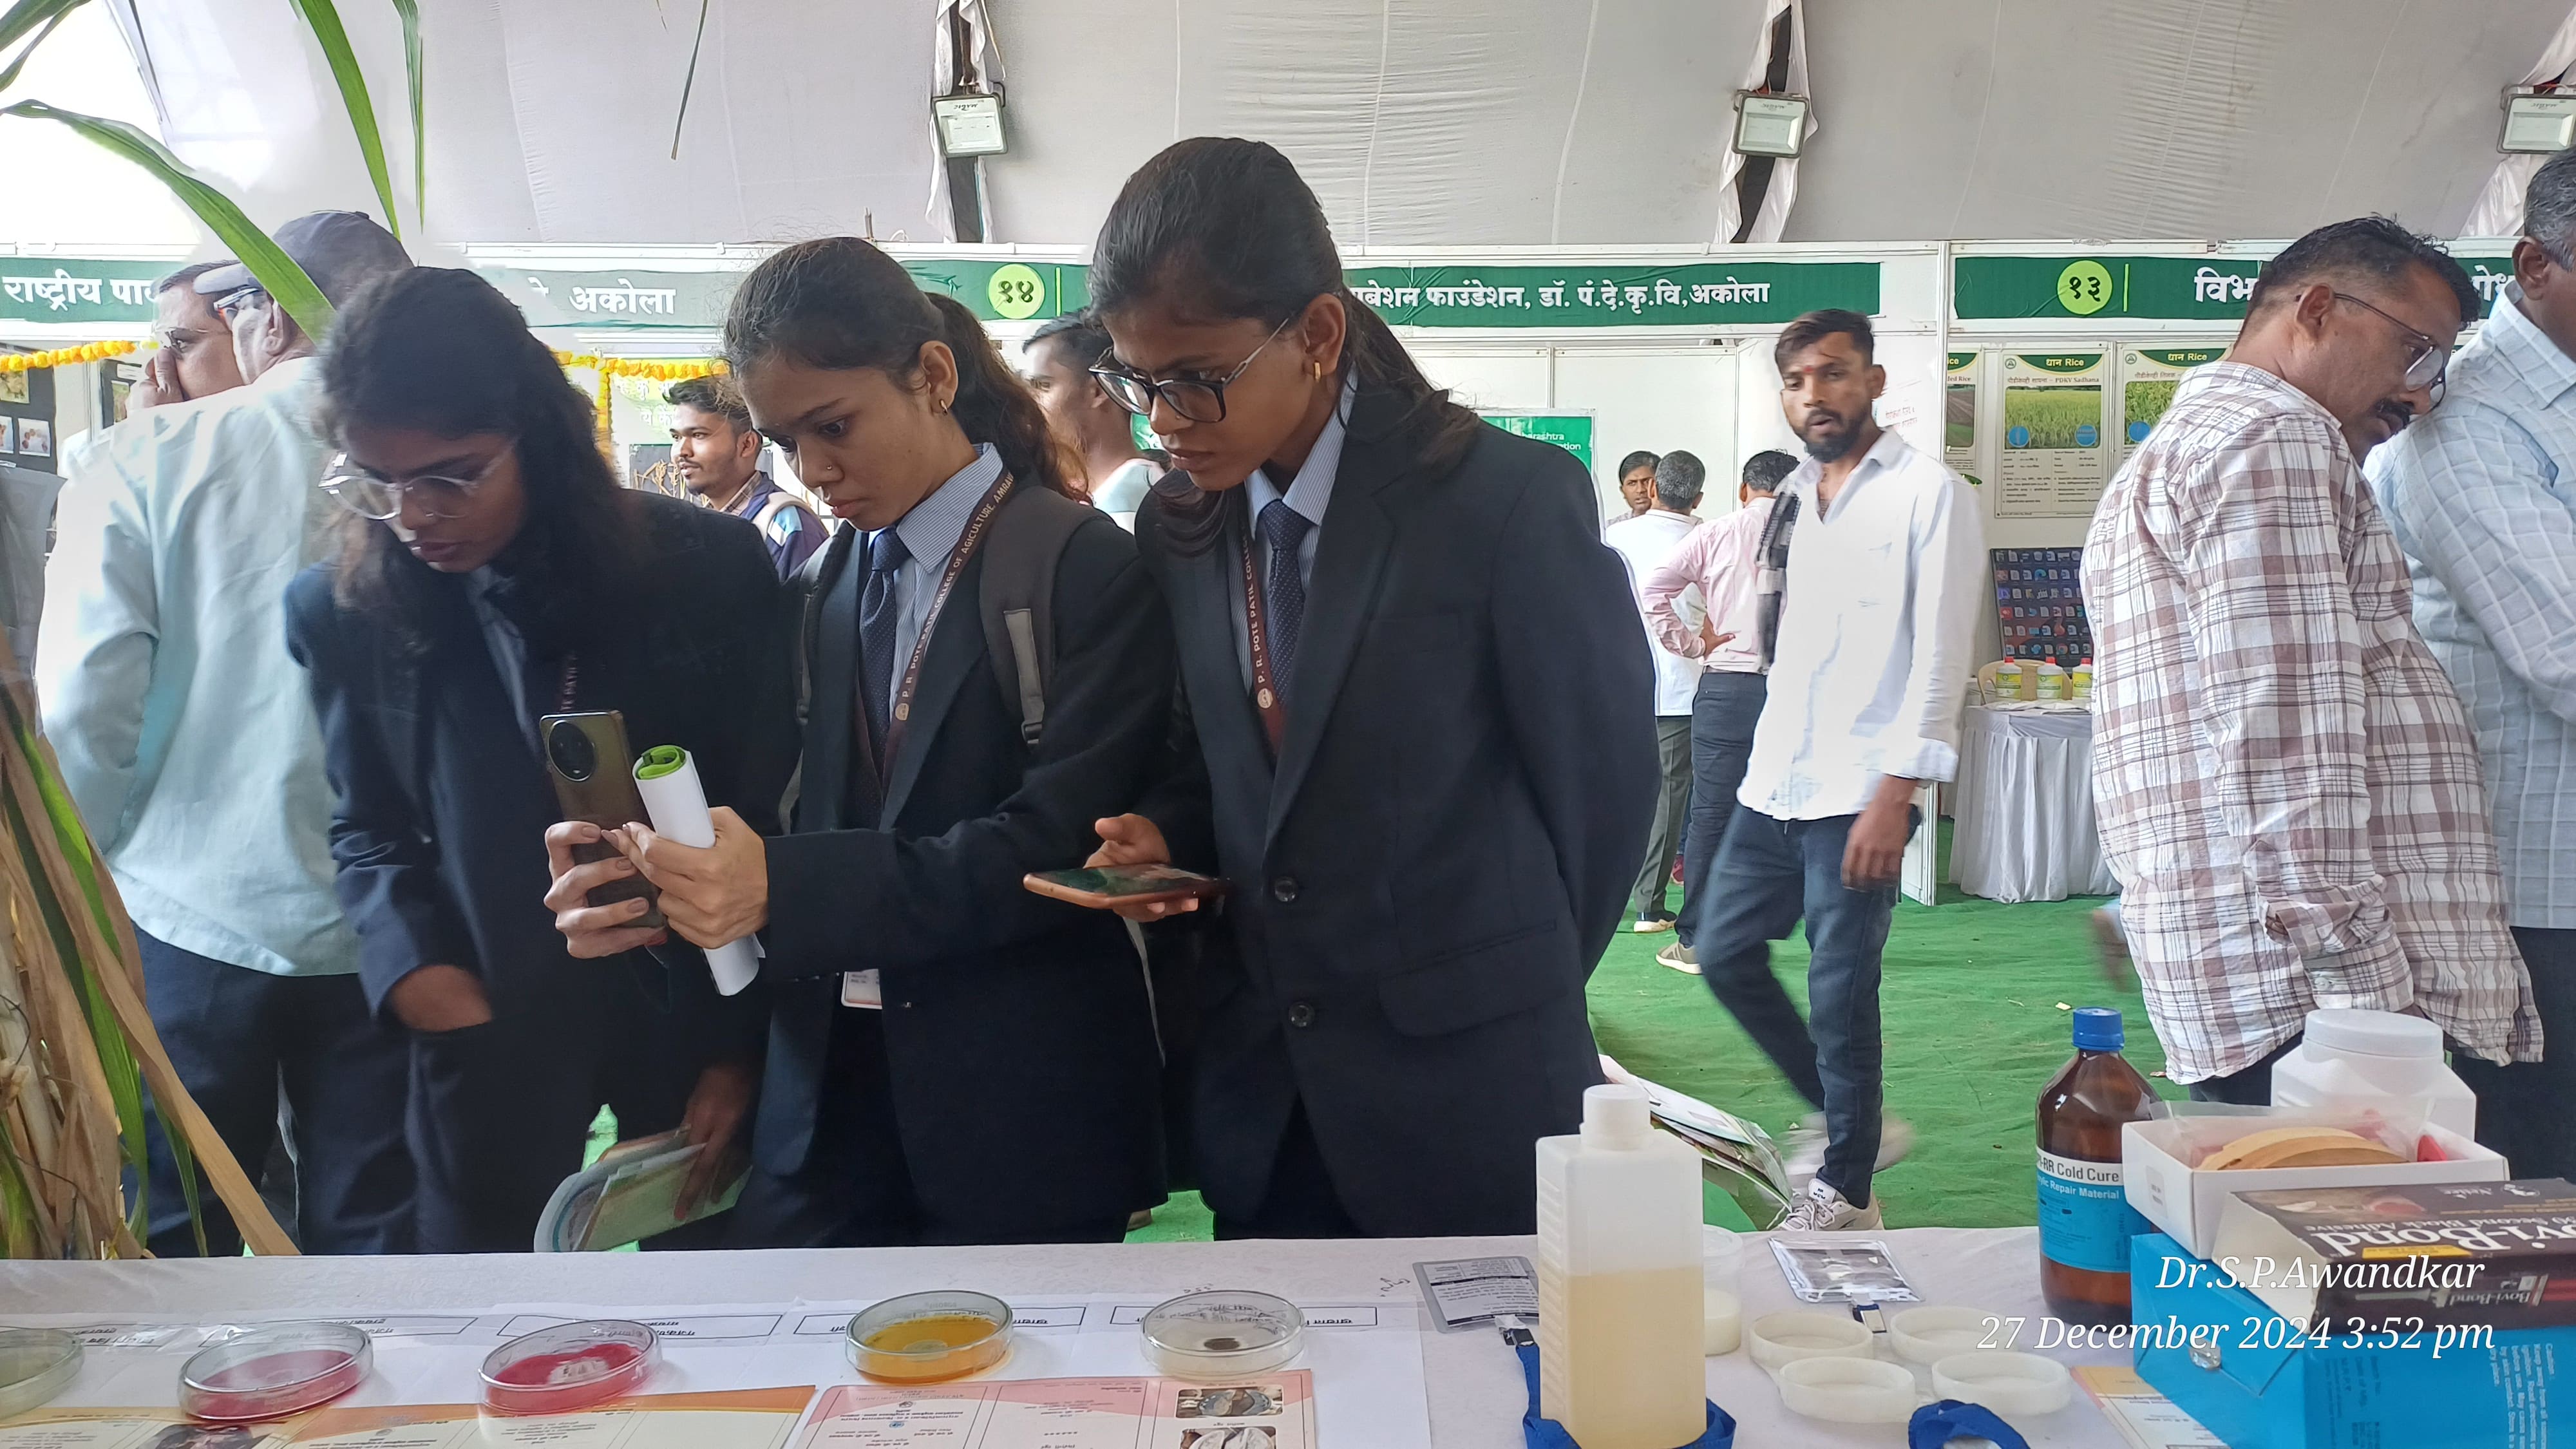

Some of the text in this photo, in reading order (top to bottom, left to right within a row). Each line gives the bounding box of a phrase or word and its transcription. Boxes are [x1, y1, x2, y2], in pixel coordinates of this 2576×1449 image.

[3, 269, 102, 312] राष्ट्रीय
[998, 281, 1034, 303] १४
[1425, 279, 1531, 310] फाउंडेशन,
[1538, 279, 1570, 307] डॉ.
[2069, 276, 2101, 302] १३
[2194, 267, 2259, 303] विभ
[569, 278, 676, 315] अकोला
[2046, 358, 2085, 366] धान Rice
[2168, 353, 2208, 361] धान Rice
[1247, 585, 1256, 618] PATIL
[910, 647, 922, 670] POTE
[934, 571, 956, 608] COLLEGE
[953, 556, 963, 568] OF
[1251, 622, 1261, 652] POTE
[2057, 1163, 2083, 1180] Cold
[2087, 1168, 2119, 1182] Cure
[2050, 1180, 2076, 1195] Repair
[2079, 1188, 2119, 1200] Material
[2304, 1221, 2396, 1233] Adhesive
[2402, 1220, 2467, 1230] Block
[2469, 1217, 2548, 1228] Second
[2450, 1291, 2531, 1306] Bovi-Bond
